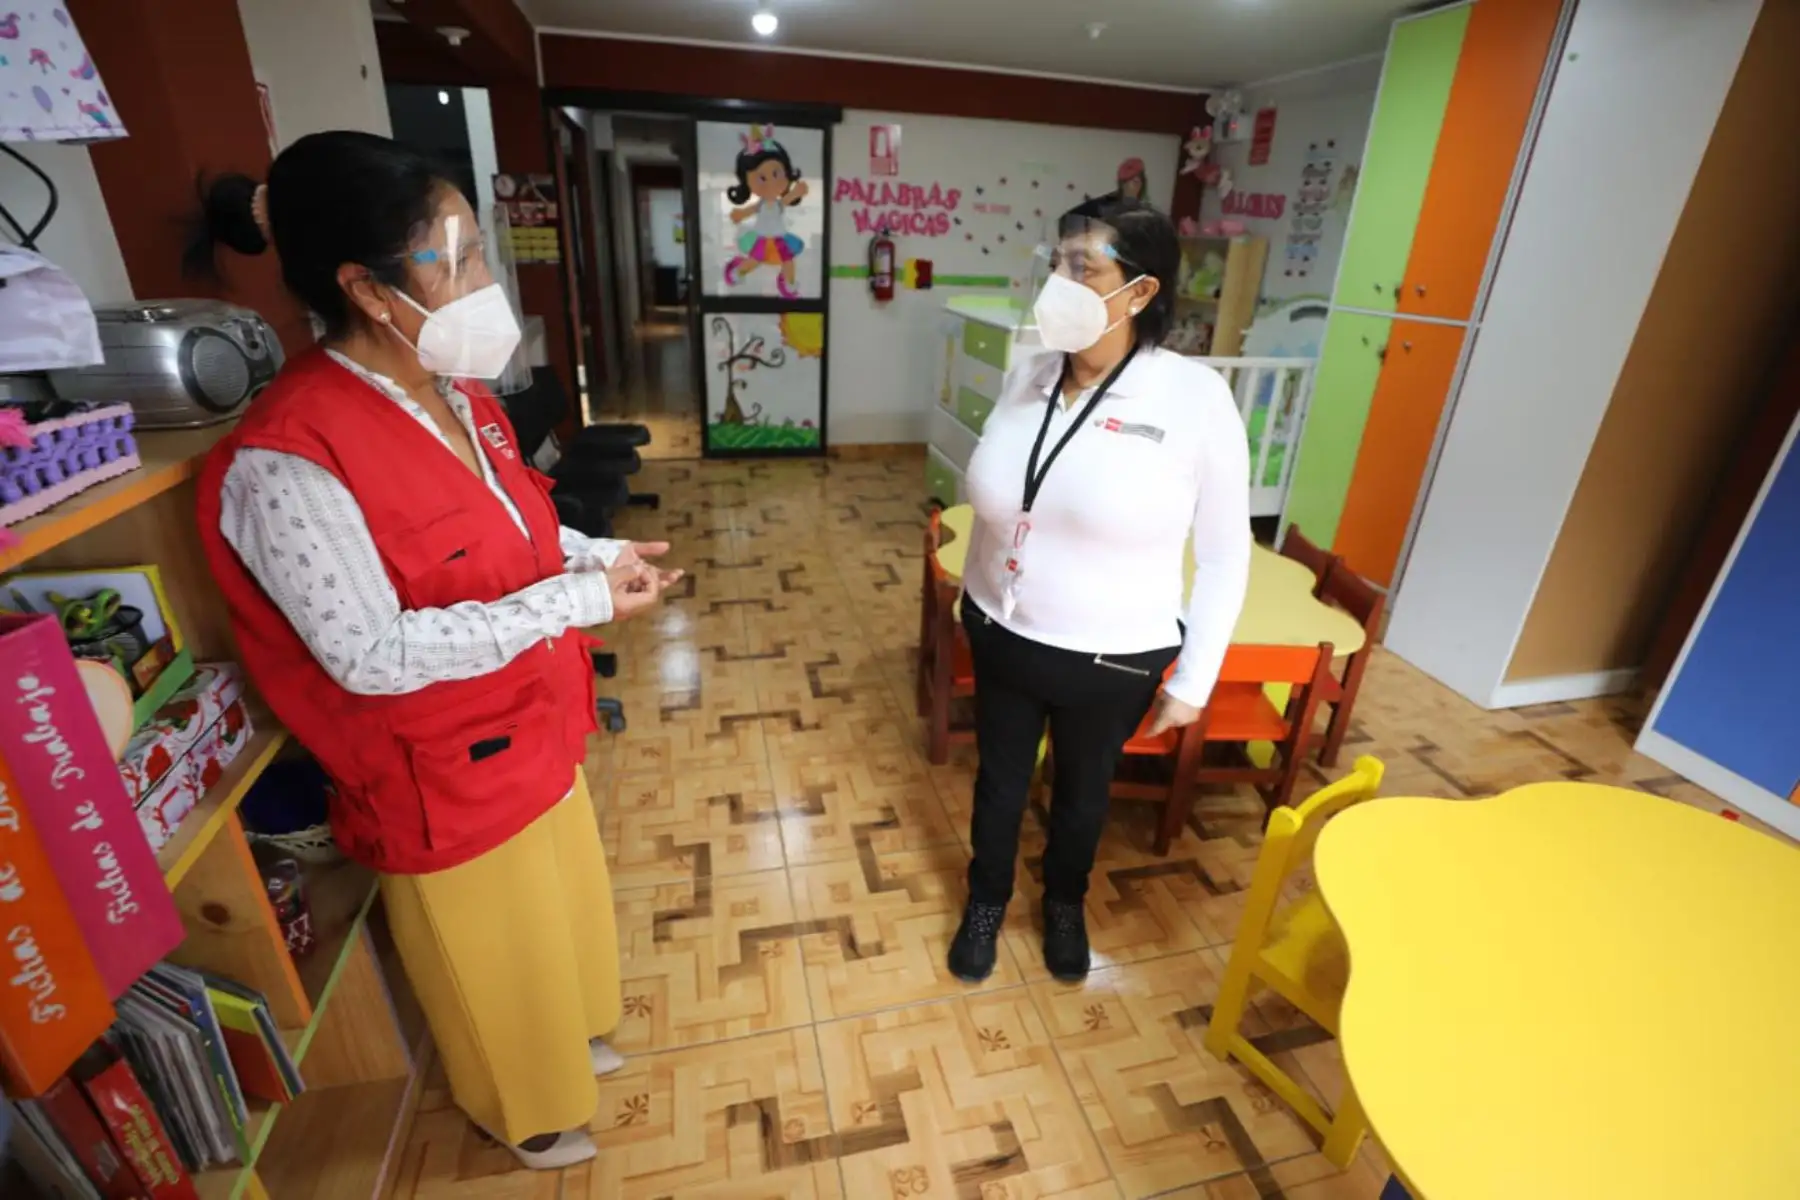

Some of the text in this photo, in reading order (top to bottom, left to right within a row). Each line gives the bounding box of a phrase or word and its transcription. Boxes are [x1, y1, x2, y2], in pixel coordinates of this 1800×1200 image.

[833, 177, 962, 211] PALABRAS
[16, 673, 140, 924] Fichas de Trabajo
[7, 924, 67, 1024] Fichas
